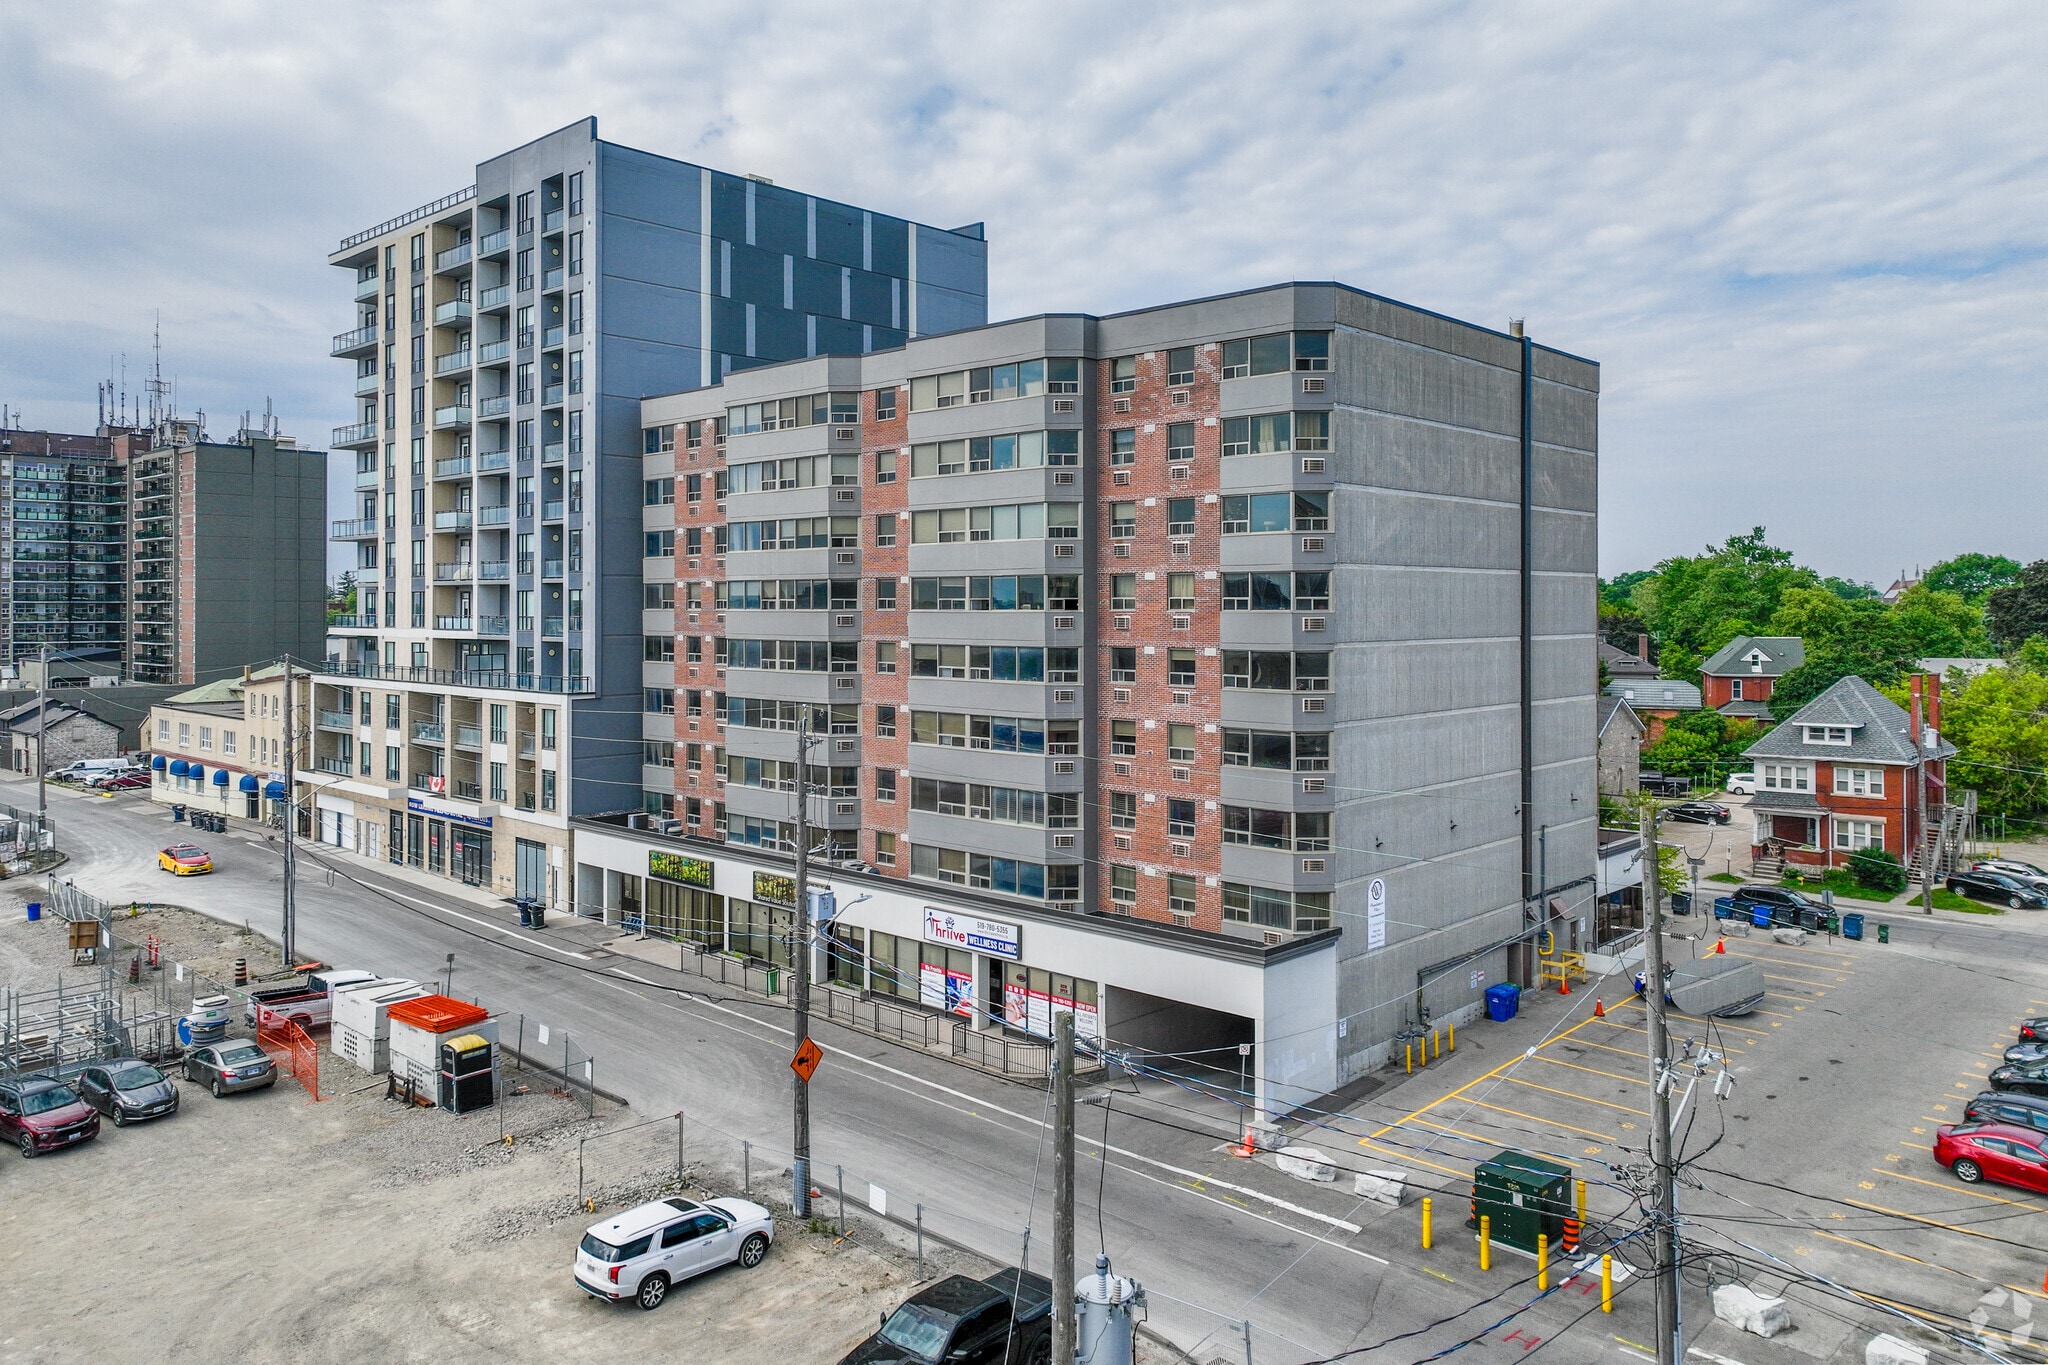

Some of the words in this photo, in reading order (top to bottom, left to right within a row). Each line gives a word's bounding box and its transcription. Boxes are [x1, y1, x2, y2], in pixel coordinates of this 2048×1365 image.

[969, 935, 998, 951] WELLNESS
[998, 941, 1017, 953] CLINIC
[1076, 1002, 1086, 1011] NOW
[1085, 1004, 1097, 1013] OPEN
